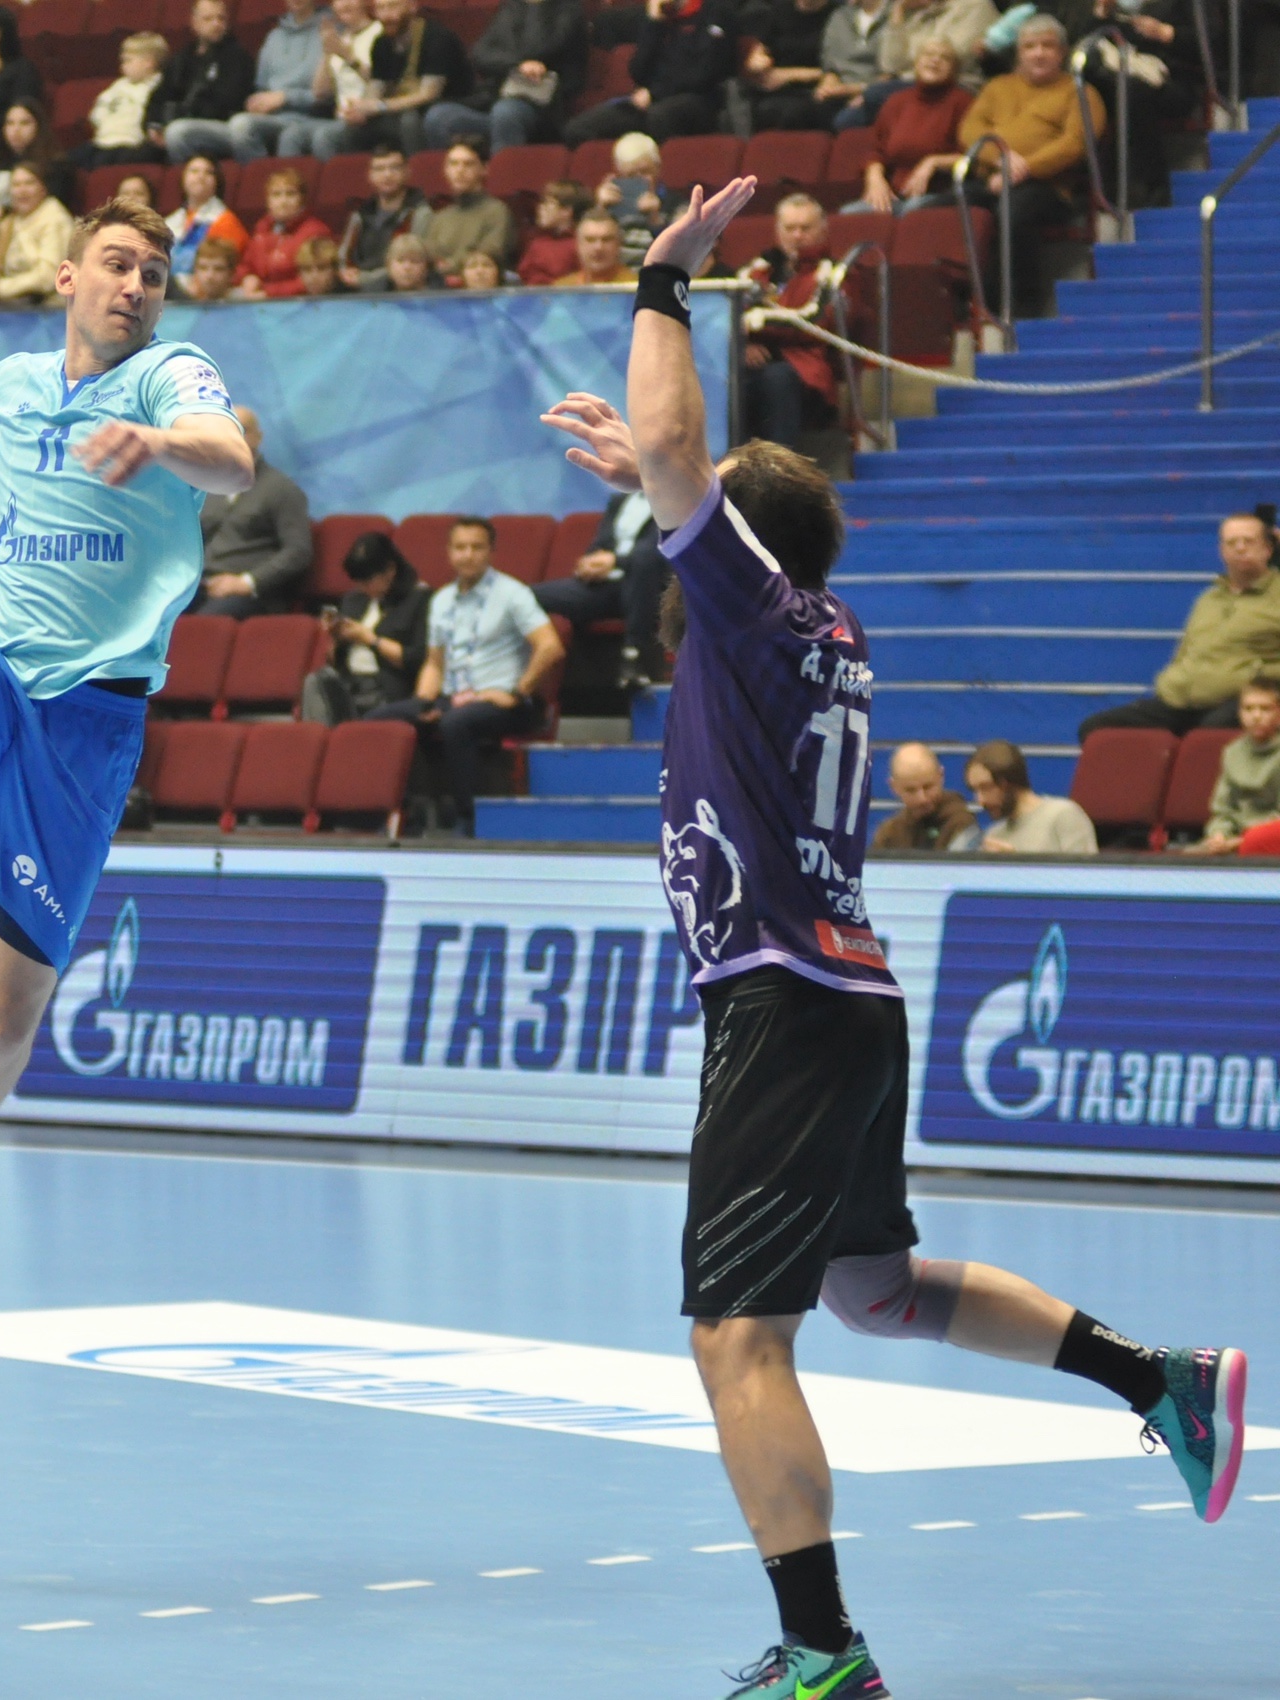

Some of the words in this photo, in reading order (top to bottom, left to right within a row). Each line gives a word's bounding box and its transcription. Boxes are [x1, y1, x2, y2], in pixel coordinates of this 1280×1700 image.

[35, 426, 71, 472] 11
[18, 533, 125, 562] ГАЗПРОМ
[403, 924, 702, 1077] ГАЗПР
[127, 1011, 330, 1087] ГАЗПРОМ
